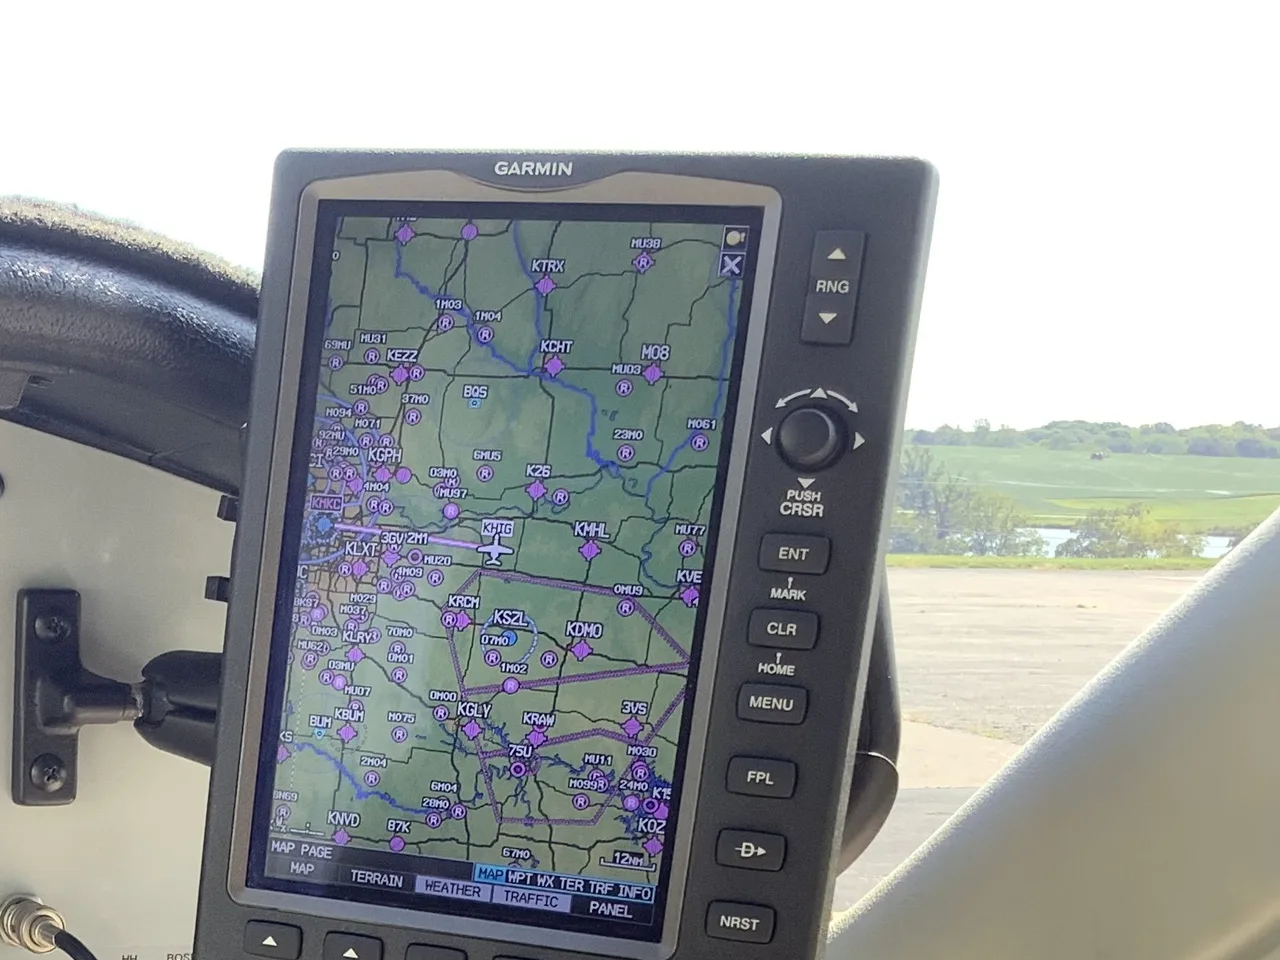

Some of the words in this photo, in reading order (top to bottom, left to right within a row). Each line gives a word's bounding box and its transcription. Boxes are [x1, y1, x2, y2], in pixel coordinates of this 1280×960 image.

[494, 162, 573, 176] GARMIN
[532, 259, 565, 272] KTRX
[816, 280, 849, 294] RNG
[540, 340, 573, 353] KCHT
[787, 490, 821, 501] PUSH
[780, 502, 824, 517] CRSR
[483, 522, 513, 535] KHIG
[574, 522, 609, 538] KMHL
[778, 547, 809, 561] ENT
[770, 587, 807, 600] MARK
[448, 595, 480, 608] KRCM
[565, 622, 603, 638] KDMO
[766, 622, 797, 636] CLR
[757, 662, 795, 676] HOME
[749, 696, 793, 711] MENU
[523, 713, 555, 726] KRAW
[747, 771, 774, 785] FPL
[327, 810, 360, 827] KNVD
[271, 841, 295, 853] MAP
[301, 844, 333, 858] PAGE
[290, 862, 315, 875] MAP
[351, 869, 403, 887] TERRAIN
[478, 867, 504, 878] MAP
[507, 872, 533, 884] WPT
[537, 876, 554, 888] WX
[560, 878, 584, 891] TER
[589, 882, 613, 895] TRF
[619, 886, 651, 900] INFO
[425, 879, 481, 898] WEATHER
[504, 890, 558, 907] TRAFFIC
[590, 901, 633, 918] PANEL
[720, 915, 760, 931] NRST
